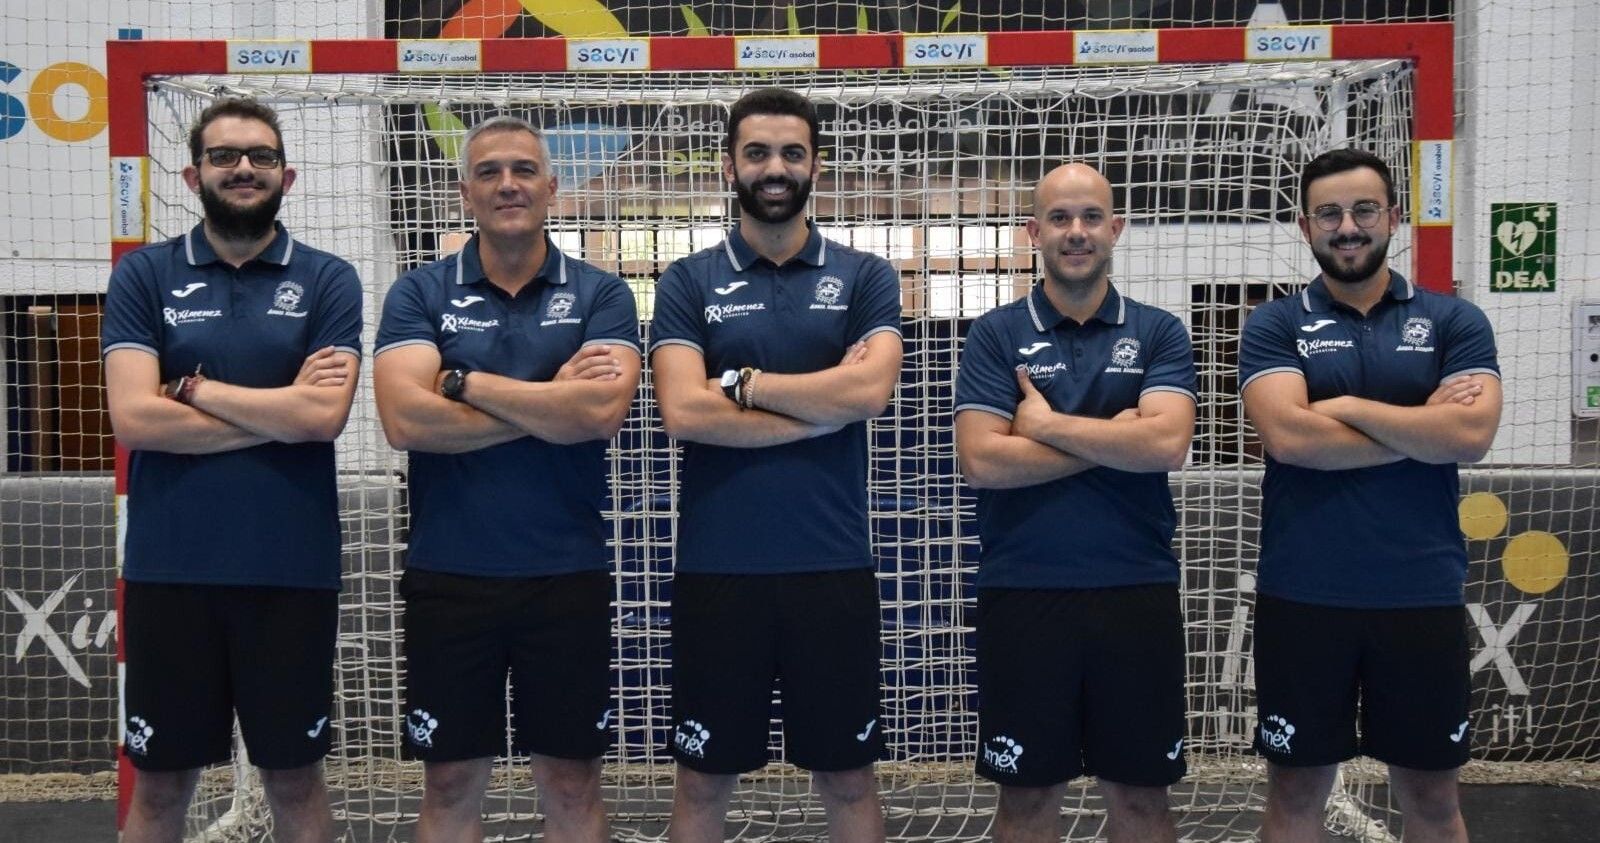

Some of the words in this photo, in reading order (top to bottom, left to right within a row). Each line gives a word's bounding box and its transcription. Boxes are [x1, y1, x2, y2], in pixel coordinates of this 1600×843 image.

[914, 43, 976, 60] sacyr
[1257, 36, 1320, 52] sacyr
[238, 49, 300, 66] sacyr
[578, 47, 639, 63] sacyr
[789, 51, 815, 59] asobal
[1495, 271, 1550, 289] DEA
